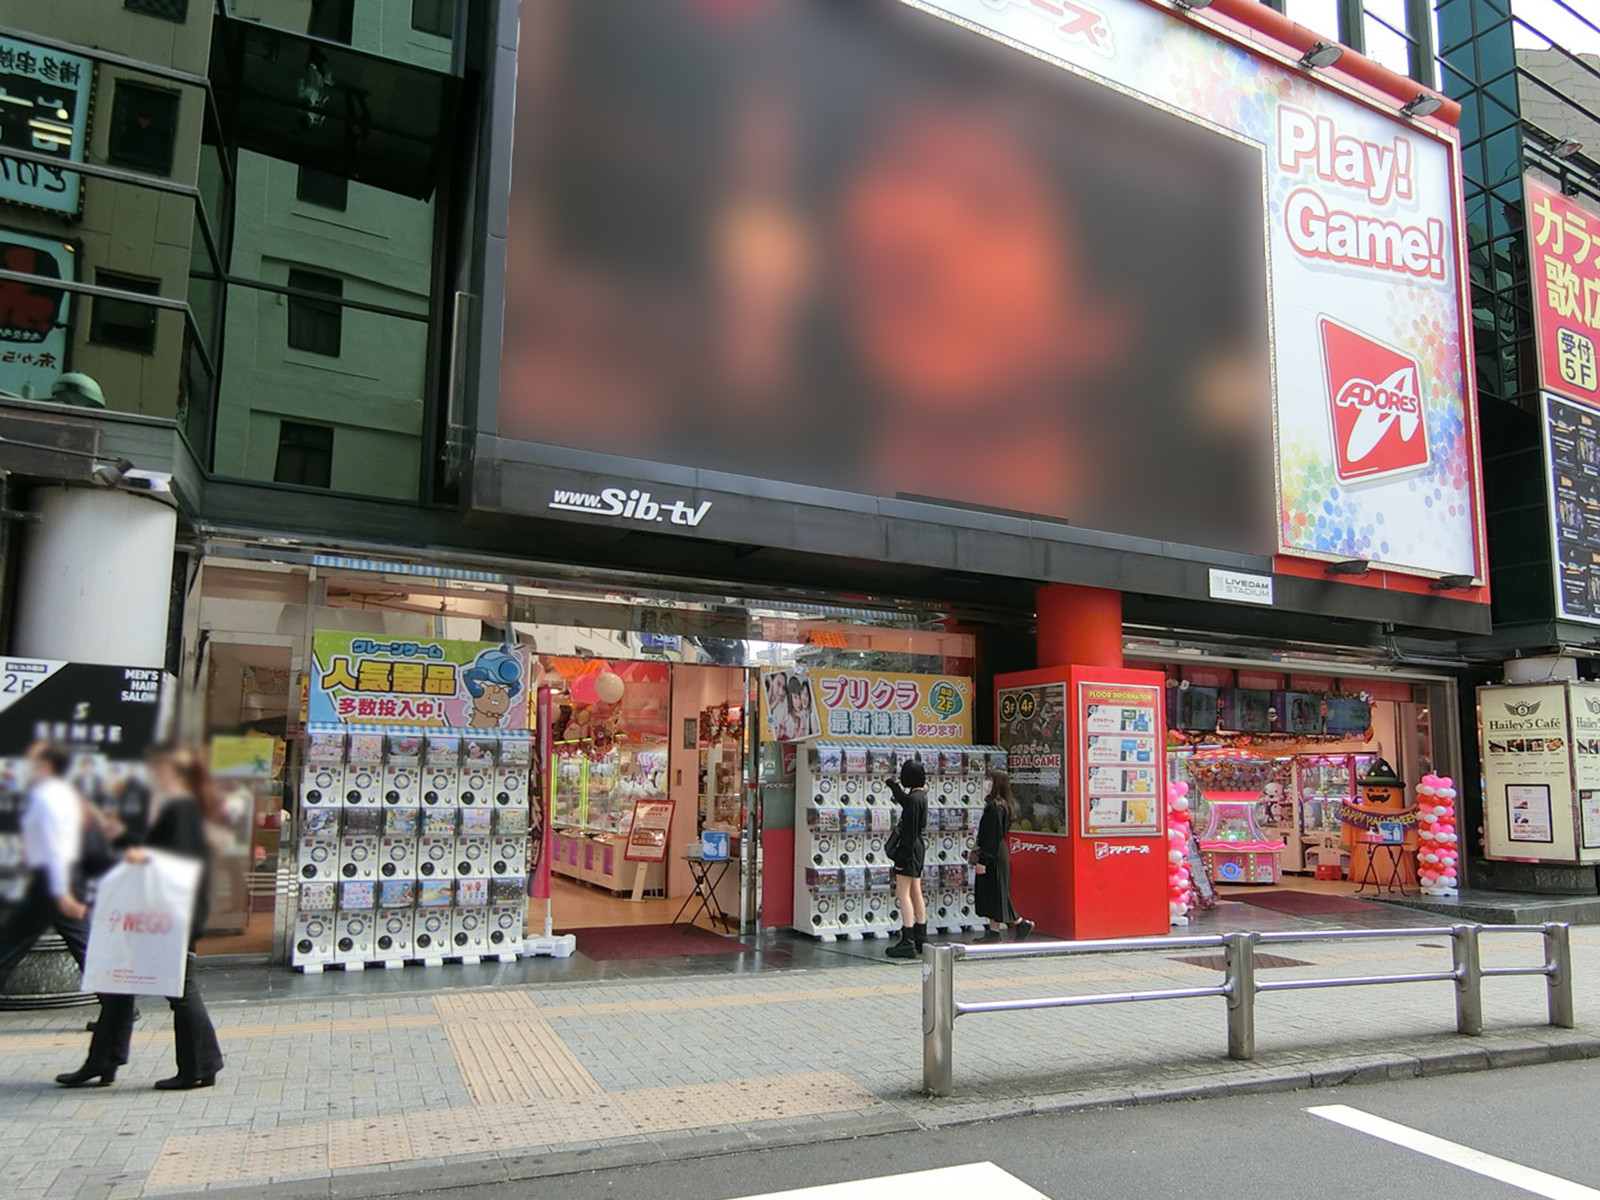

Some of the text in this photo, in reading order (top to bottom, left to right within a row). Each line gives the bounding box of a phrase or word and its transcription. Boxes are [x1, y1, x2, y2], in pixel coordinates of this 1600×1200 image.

[1277, 104, 1413, 205] Play!
[1285, 188, 1445, 280] Game!
[1533, 197, 1600, 269] カラ
[1562, 331, 1591, 362] 受付
[1565, 360, 1591, 385] 5F
[1338, 380, 1418, 413] ADORES
[1225, 577, 1269, 589] LIVEDAM
[1225, 585, 1269, 597] STADIUM
[352, 639, 444, 660] クレーンゲーム
[3, 674, 34, 694] 2F
[124, 669, 159, 680] MEN'S
[322, 658, 457, 696] 人気景品
[131, 681, 158, 691] HAIR
[822, 677, 920, 710] プリクラ
[338, 698, 444, 718] 多数投入中!
[936, 695, 953, 712] 2F
[1003, 701, 1015, 715] 3F
[1021, 699, 1033, 713] 4F
[830, 710, 913, 737] 最新機種
[917, 724, 963, 738] あります!
[1535, 717, 1561, 728] Café
[1033, 754, 1062, 768] GAME
[1338, 806, 1366, 824] HAPPY
